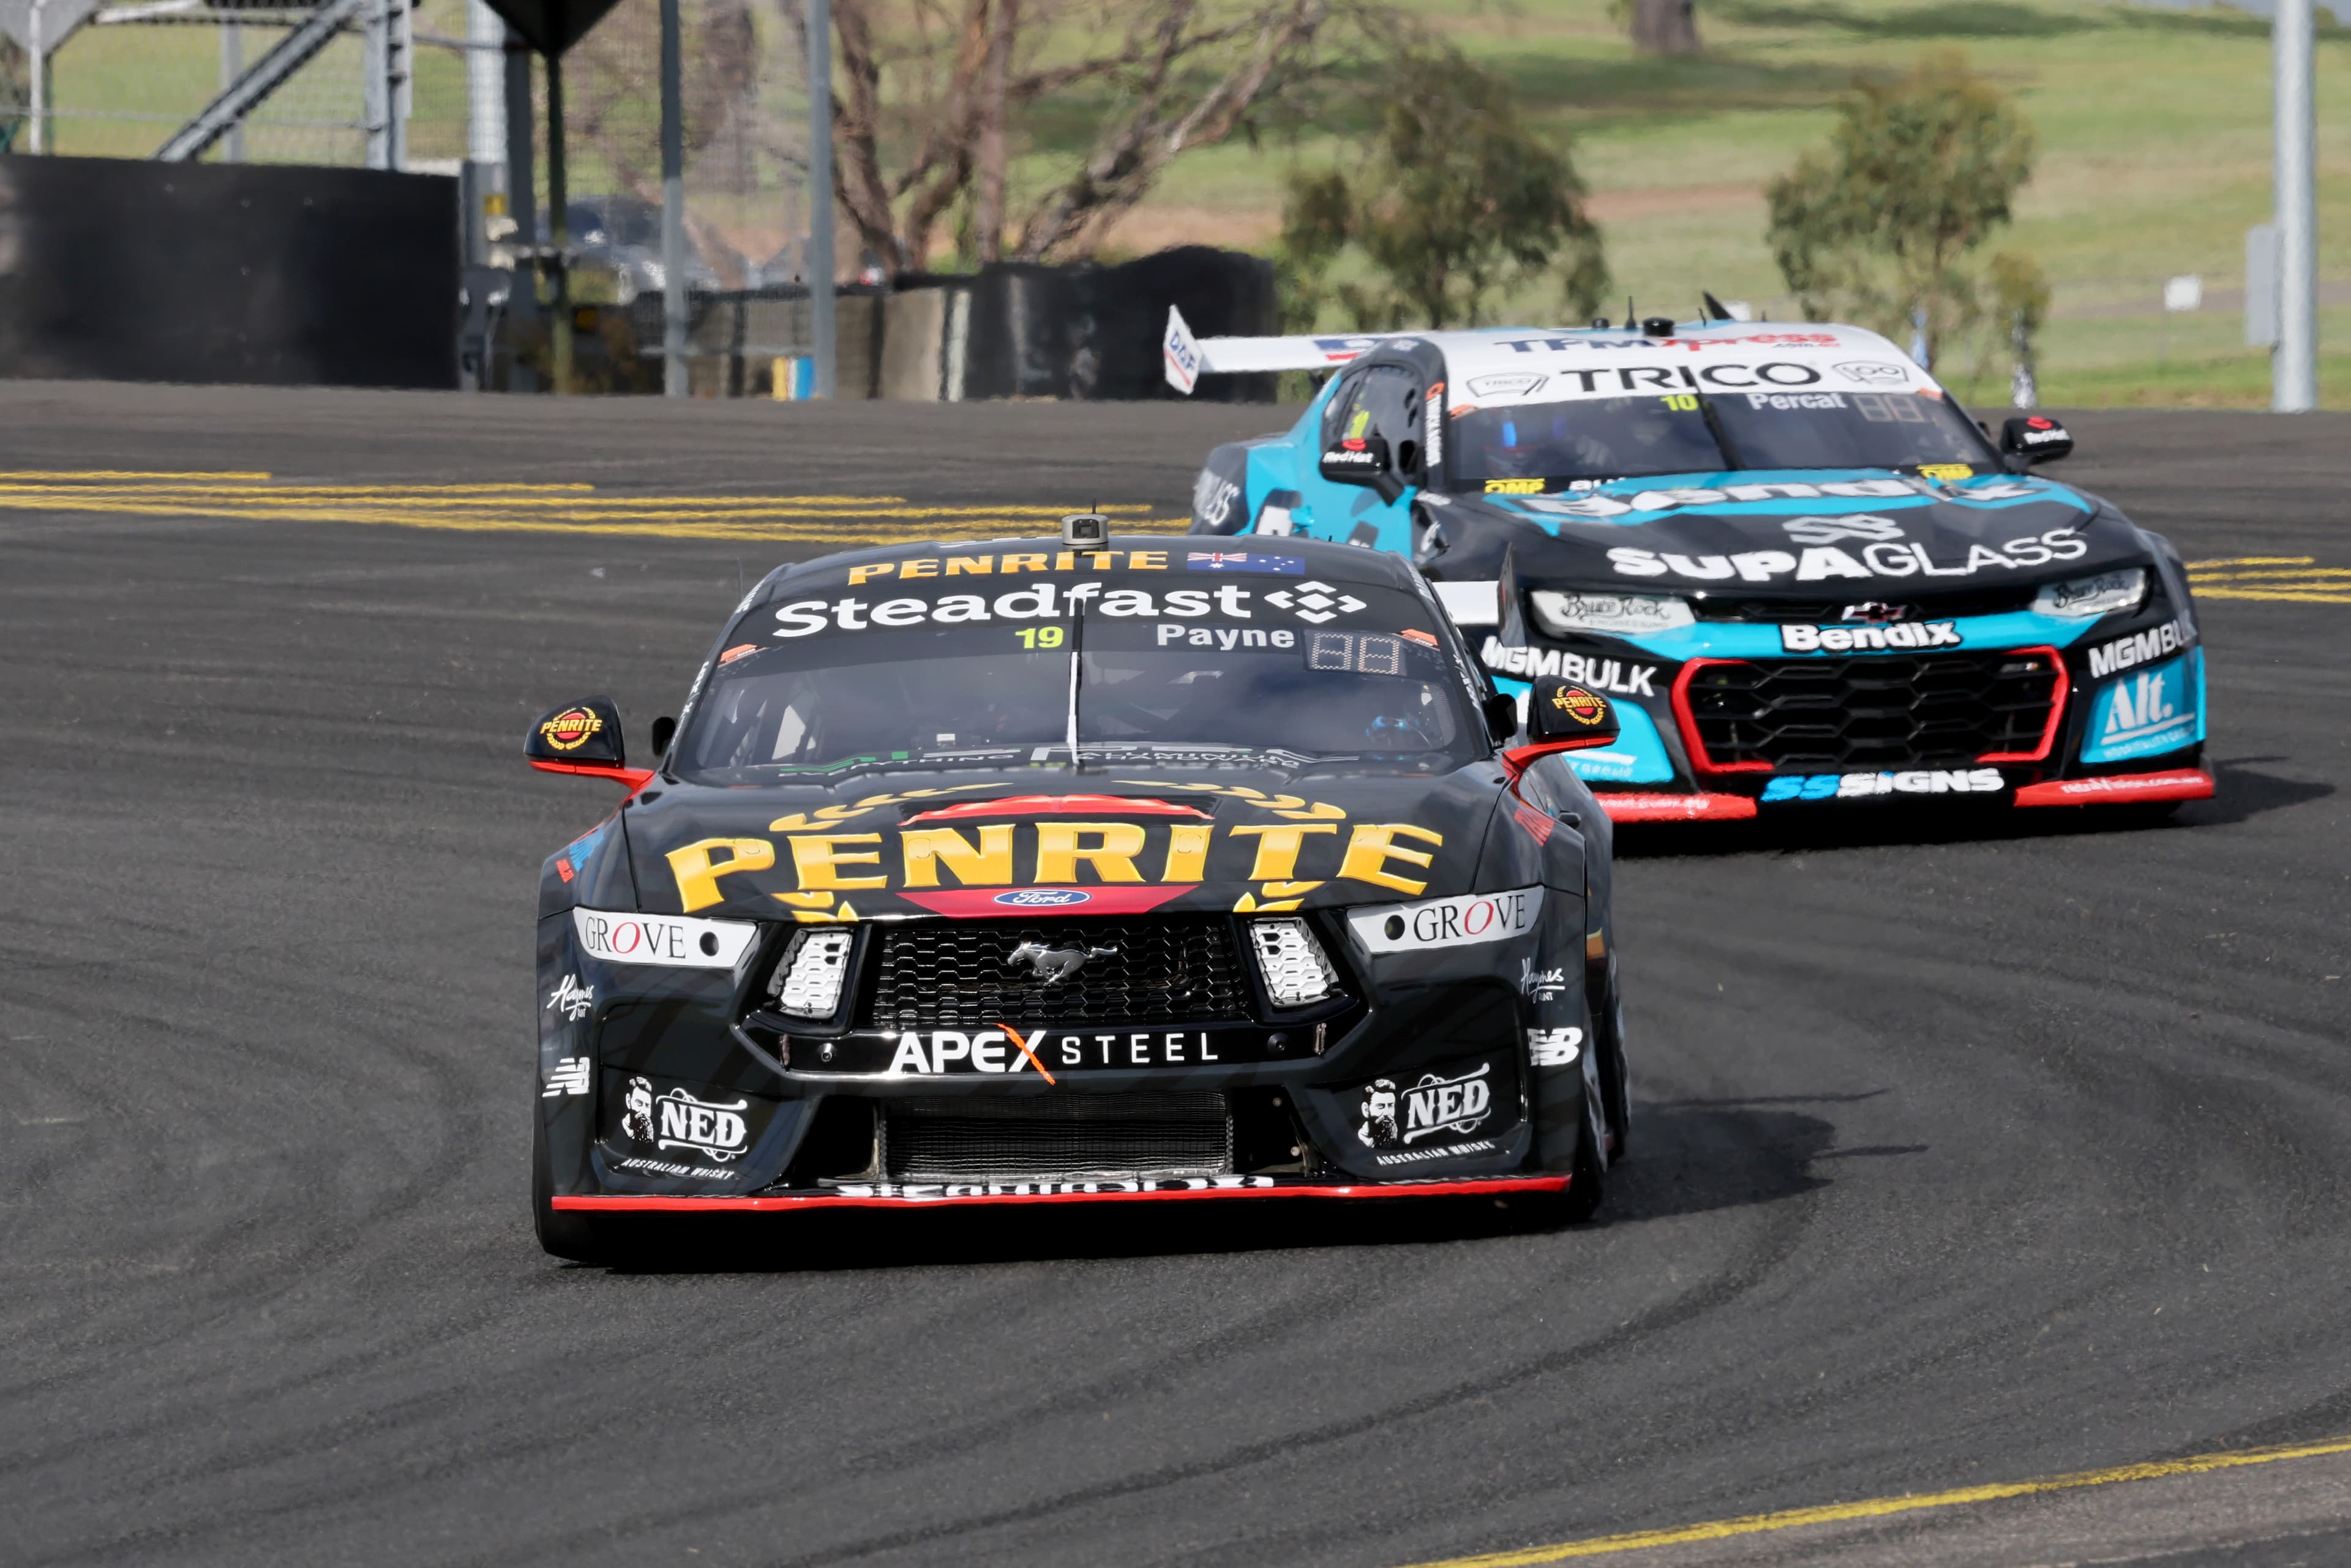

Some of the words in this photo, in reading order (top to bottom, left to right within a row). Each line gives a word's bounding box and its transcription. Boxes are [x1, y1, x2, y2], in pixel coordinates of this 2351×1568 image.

[1560, 362, 1821, 392] TRICO
[1660, 393, 1700, 411] 10
[1745, 392, 1848, 410] Percat
[847, 550, 1169, 586] PENRITE
[1605, 527, 2087, 582] SUPAGLASS
[772, 581, 1251, 638] Steadfast
[1014, 625, 1065, 650] 19
[1157, 623, 1295, 651] Payne
[1781, 621, 1962, 651] Bendix
[1551, 696, 1607, 709] PENRITE
[540, 718, 603, 734] PENRITE
[666, 822, 1443, 913] PENRITE
[1013, 891, 1073, 904] Ford
[1413, 894, 1526, 942] GROVE
[585, 916, 686, 959] GROVE
[888, 1023, 1056, 1086] APEX
[1062, 1032, 1218, 1065] STEEL
[1409, 1079, 1490, 1129] NED
[661, 1101, 747, 1148] NED
[620, 1158, 691, 1174] AUSTRALIAN
[690, 1166, 735, 1180] WHISKY
[1376, 1148, 1449, 1166] AUSTRALIAN
[1447, 1140, 1496, 1155] WHISKY
